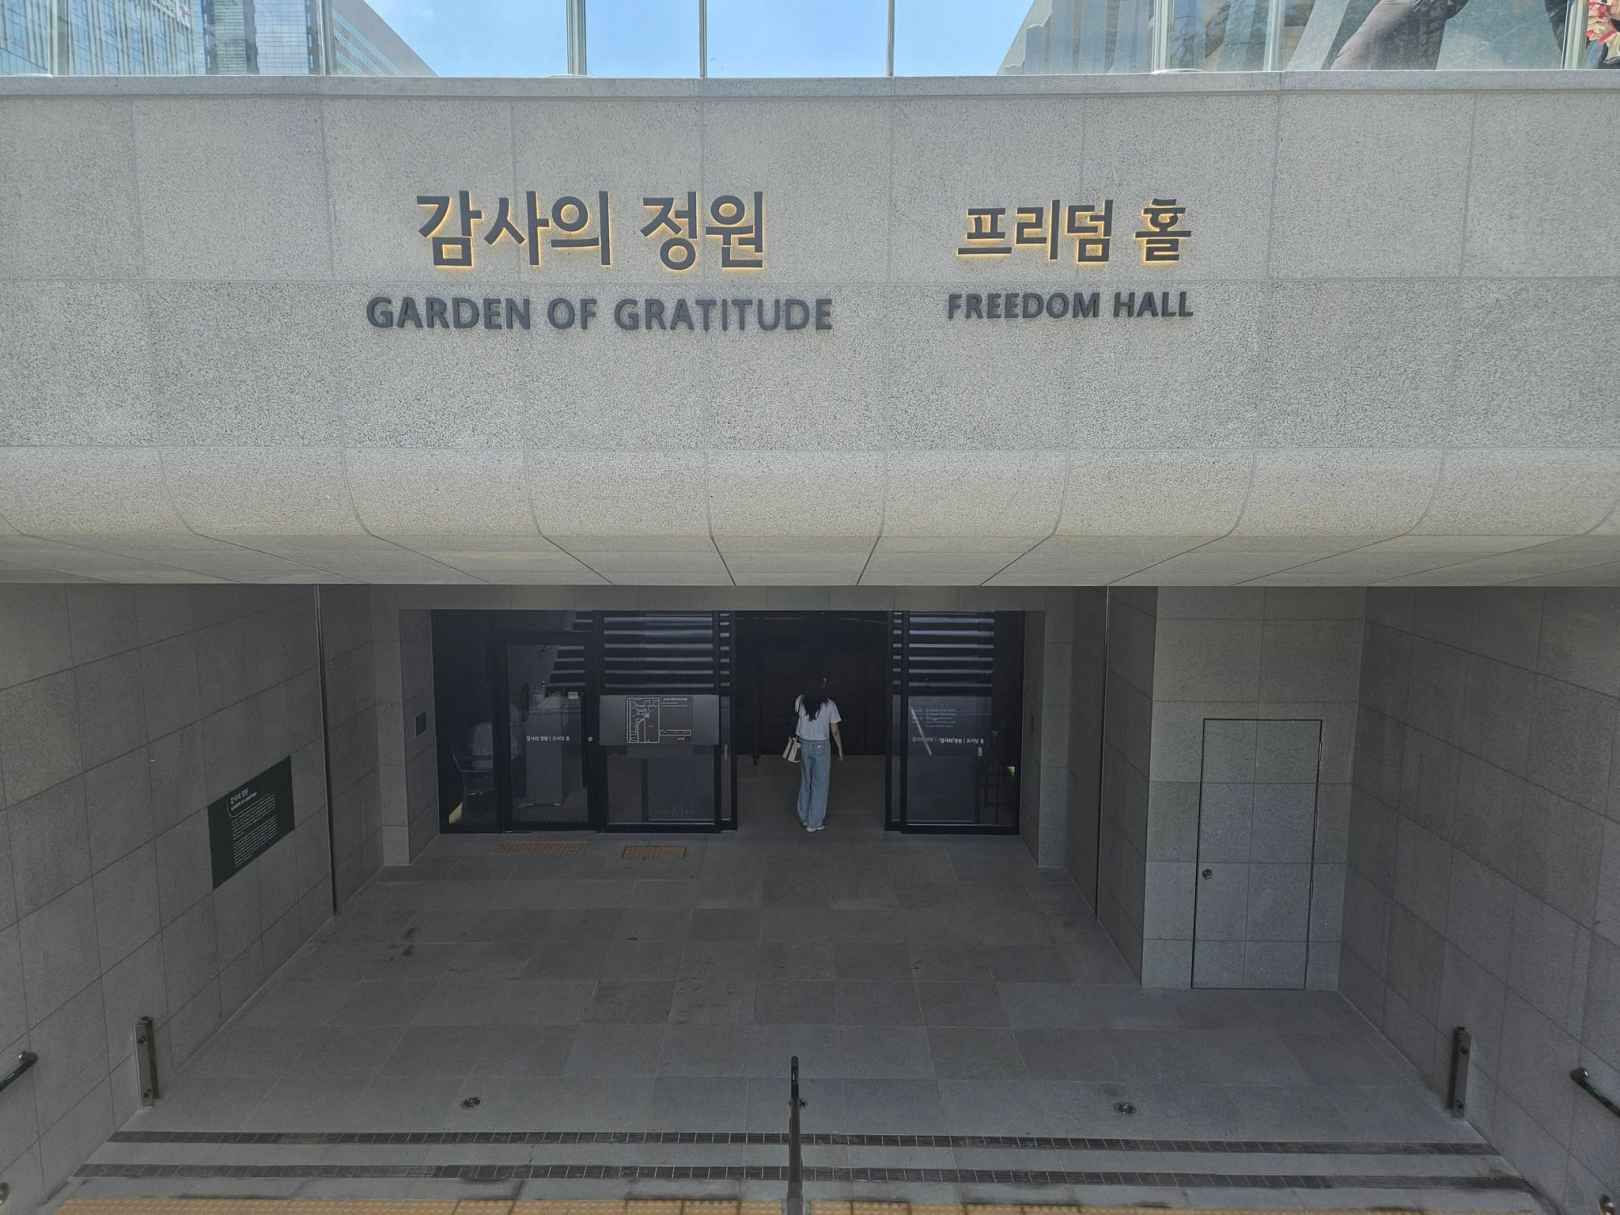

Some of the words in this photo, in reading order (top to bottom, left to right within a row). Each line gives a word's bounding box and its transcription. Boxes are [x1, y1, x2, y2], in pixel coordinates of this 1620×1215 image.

[416, 190, 611, 267] 감사의
[640, 190, 764, 271] 정원
[957, 199, 1113, 262] 프리덤
[1135, 198, 1192, 262] 홀
[366, 296, 531, 331] GARDEN
[547, 297, 597, 330] OF
[613, 297, 833, 332] GRATITUDE
[947, 292, 1100, 320] FREEDOM
[1113, 291, 1194, 318] HALL
